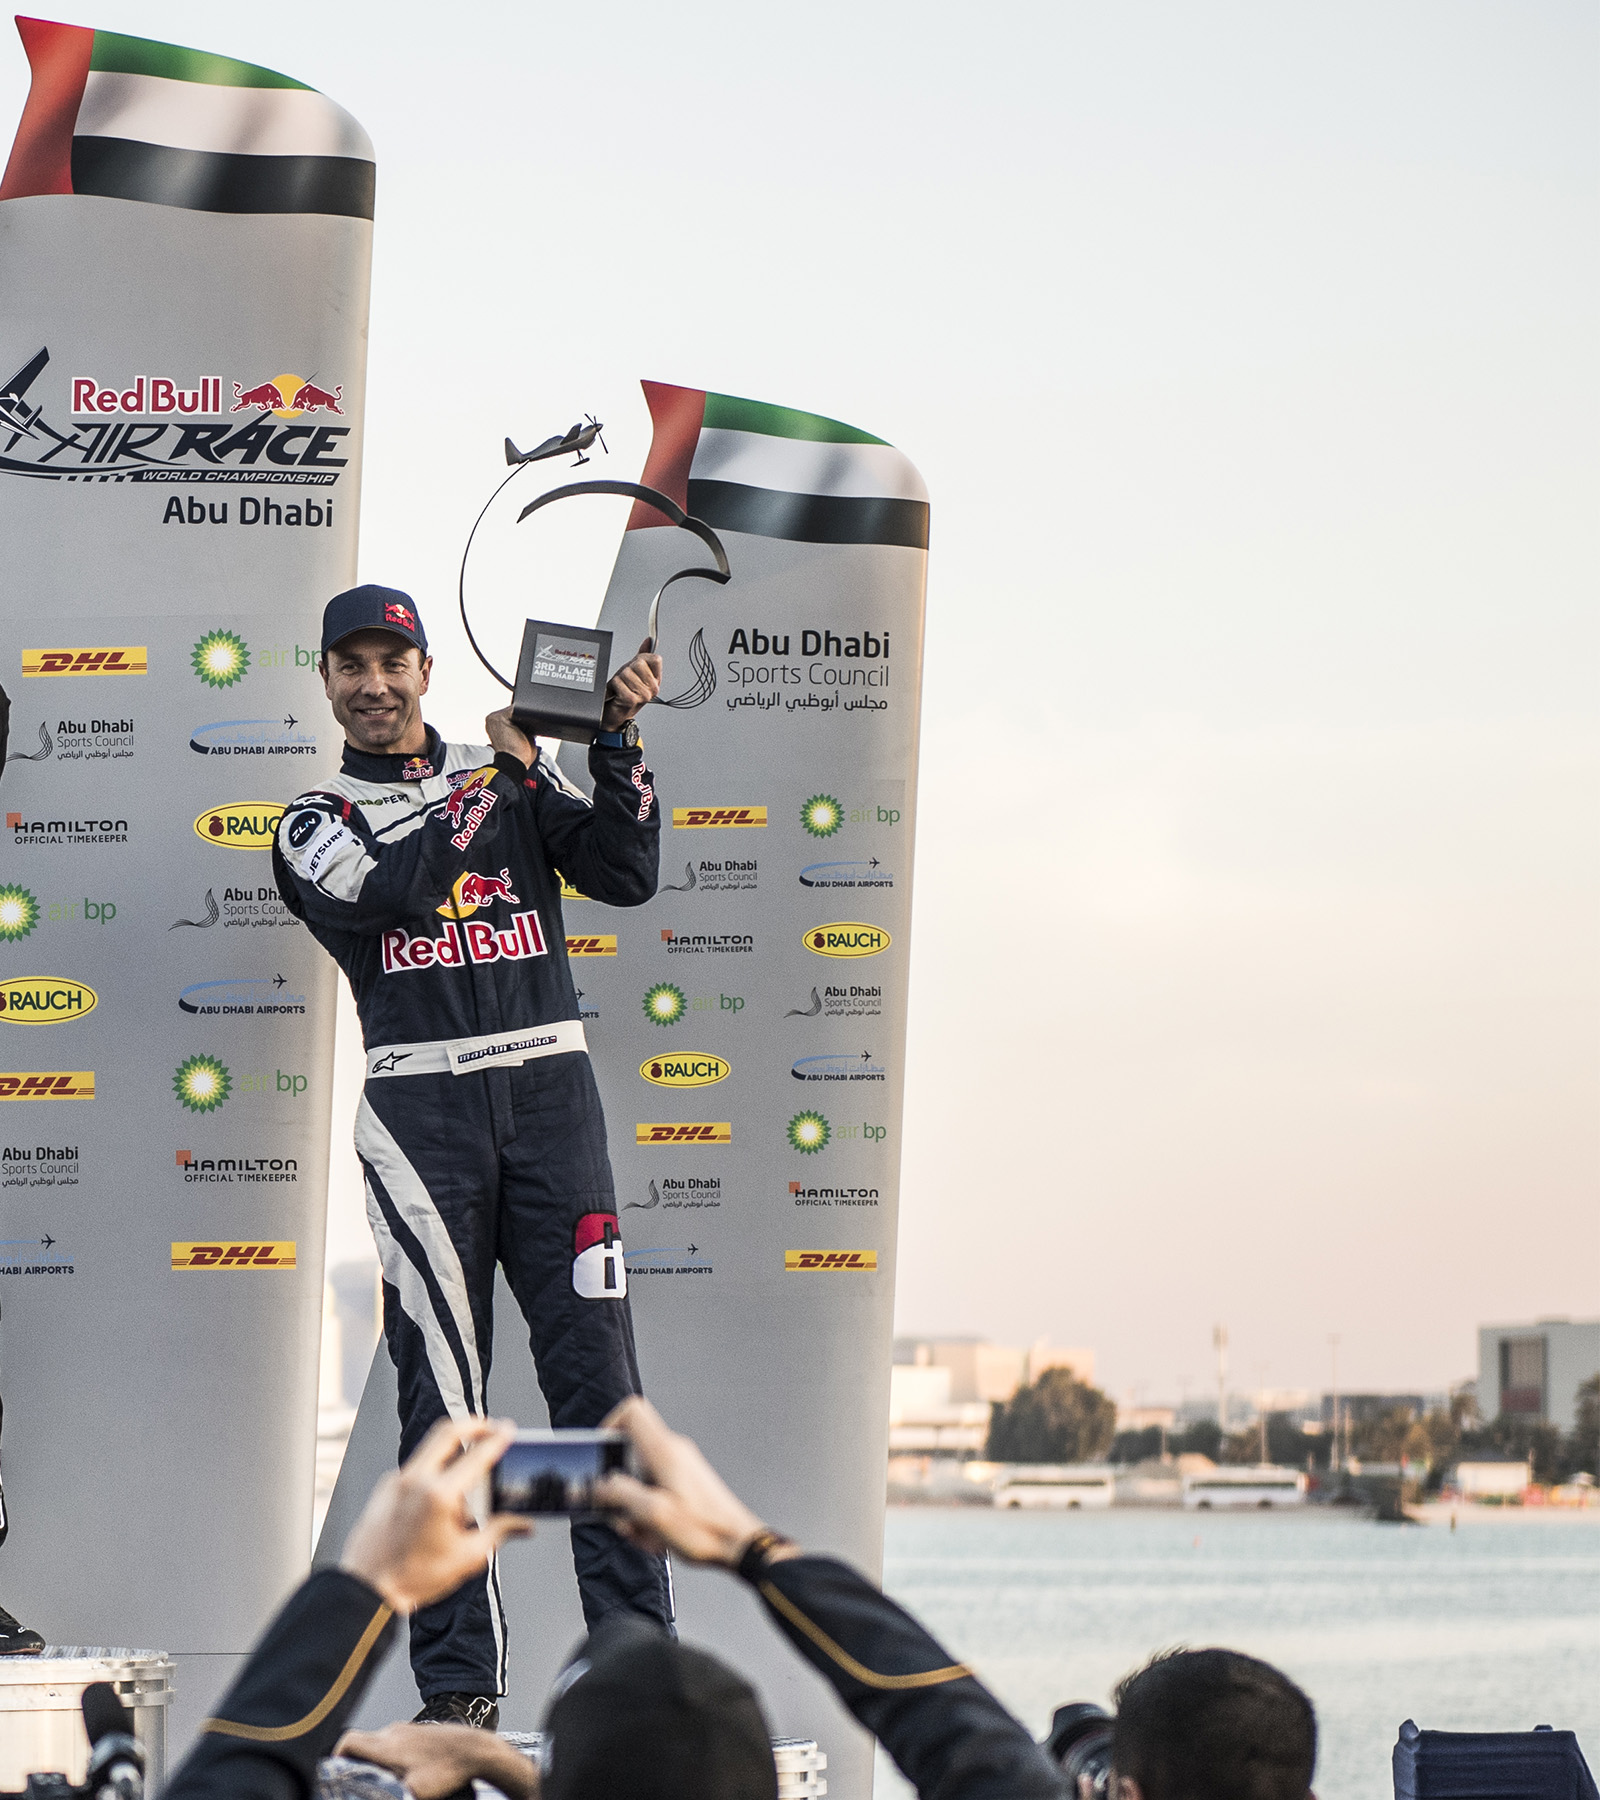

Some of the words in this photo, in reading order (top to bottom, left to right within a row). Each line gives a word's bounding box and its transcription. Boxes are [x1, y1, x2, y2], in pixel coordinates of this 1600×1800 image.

[71, 376, 146, 414] Red
[150, 376, 222, 414] Bull
[170, 420, 351, 467] RACE
[142, 471, 202, 482] WORLD
[204, 471, 335, 485] CHAMPIONSHIP
[163, 496, 228, 525] Abu
[240, 496, 333, 527] Dhabi
[728, 628, 790, 656] Abu
[802, 630, 890, 658] Dhabi
[39, 652, 131, 672] DHL
[535, 661, 556, 672] 3RD
[558, 665, 594, 677] PLACE
[551, 672, 574, 681] DHABI
[727, 661, 801, 687] Sports
[809, 663, 889, 687] Council
[727, 692, 780, 711] الرياضي
[786, 690, 839, 712] أبوظبي
[844, 695, 888, 712] مجلس
[57, 720, 87, 734] Abu
[91, 719, 134, 733] Dhabi
[57, 736, 92, 749] Sports
[95, 735, 134, 747] Council
[211, 747, 231, 755] ABU
[233, 747, 265, 755] DHABI
[268, 746, 317, 755] AIRPORTS
[403, 769, 420, 780] Red
[420, 766, 434, 777] Bull
[686, 810, 754, 825] DHL
[877, 806, 900, 826] bp
[14, 820, 128, 833] HAMILTON
[227, 816, 280, 835] RAUC
[14, 836, 64, 845] OFFICIAL
[67, 834, 128, 843] TIMEKEEPER
[309, 829, 344, 876] JETSURF
[700, 861, 721, 871] Abu
[725, 860, 757, 871] Dhabi
[700, 873, 726, 882] Sports
[728, 872, 757, 881] Council
[224, 888, 253, 901] Abu
[84, 898, 117, 925] bp
[224, 904, 259, 917] Sports
[382, 922, 466, 974] Red
[463, 910, 548, 964] Bull
[668, 935, 753, 945] HAMILTON
[828, 933, 880, 947] RAUCH
[825, 987, 847, 996] Abu
[850, 986, 881, 996] Dhabi
[9, 990, 82, 1010] RAUCH
[720, 994, 745, 1014] bp
[825, 999, 851, 1008] Sports
[853, 998, 881, 1006] Council
[200, 1006, 221, 1014] ABU
[223, 1006, 253, 1014] DHABI
[257, 1006, 305, 1014] AIRPORTS
[459, 1045, 507, 1063] martin
[510, 1037, 551, 1051] sonka
[665, 1062, 719, 1077] RAUCH
[276, 1069, 308, 1097] bp
[650, 1126, 718, 1141] DHL
[864, 1122, 886, 1142] bp
[2, 1147, 31, 1161] Abu
[36, 1146, 79, 1160] Dhabi
[2, 1163, 37, 1176] Sports
[40, 1162, 79, 1174] Council
[184, 1159, 297, 1171] HAMILTON
[184, 1174, 234, 1182] OFFICIAL
[237, 1173, 298, 1182] TIMEKEEPER
[663, 1179, 685, 1189] Abu
[688, 1178, 721, 1188] Dhabi
[663, 1191, 689, 1200] Sports
[691, 1190, 721, 1199] Council
[795, 1189, 878, 1198] HAMILTON
[189, 1246, 280, 1265] DHL
[799, 1254, 865, 1268] DHL
[24, 1266, 74, 1275] AIRPORTS
